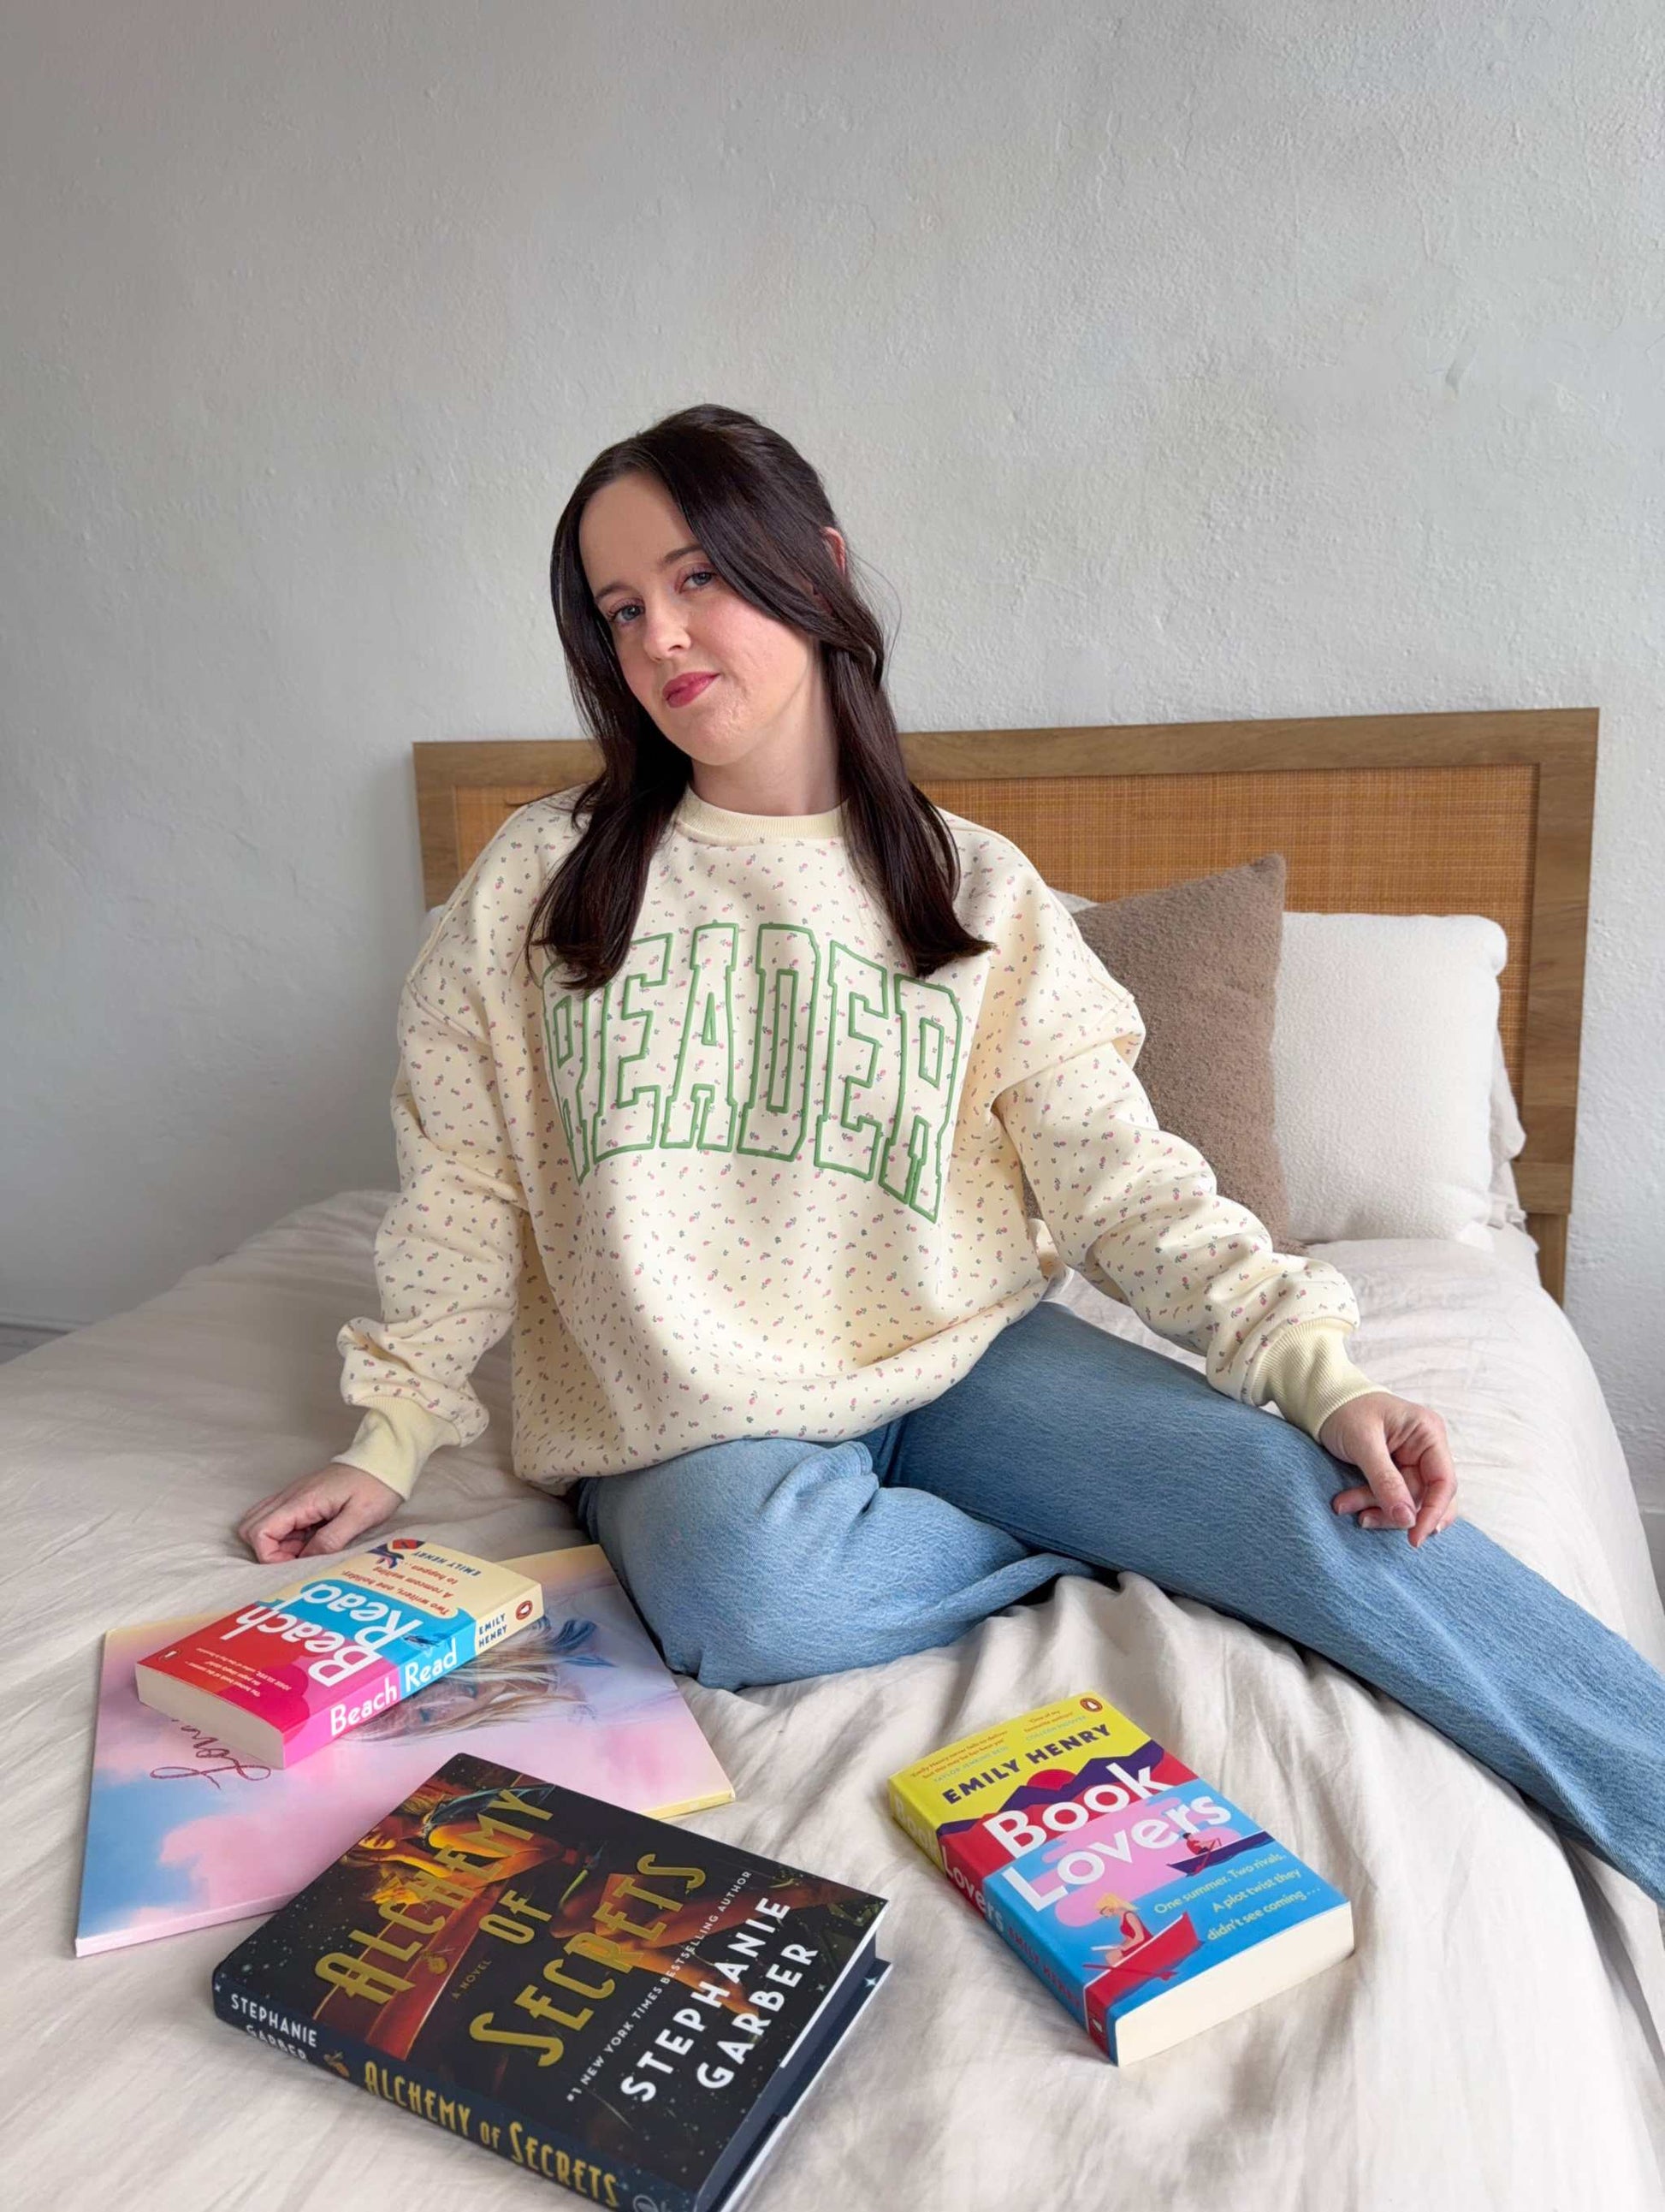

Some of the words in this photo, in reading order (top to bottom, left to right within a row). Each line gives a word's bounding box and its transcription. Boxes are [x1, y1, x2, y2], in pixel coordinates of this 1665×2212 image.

[542, 919, 963, 1224] READER
[376, 1582, 395, 1592] one
[412, 1551, 445, 1564] HENRY
[447, 1560, 481, 1576] EMILY
[220, 1606, 383, 1687] Beach
[271, 1583, 424, 1652] Read
[430, 1602, 450, 1616] Two
[478, 1613, 506, 1635] EMILY
[478, 1624, 507, 1648] HENRY
[330, 1676, 398, 1736] Beach
[404, 1637, 458, 1693] Read
[942, 1758, 1021, 1805] EMILY
[1025, 1723, 1111, 1764] HENRY
[982, 1762, 1176, 1859] Book
[942, 1845, 1004, 1932] Lovers
[1002, 1795, 1231, 1913] Lovers
[1154, 1897, 1182, 1913] One
[1182, 1877, 1230, 1902] summer.
[1228, 1865, 1254, 1878] Two
[1253, 1852, 1286, 1870] rivals.
[1212, 1901, 1224, 1913] A
[1224, 1889, 1248, 1910] plot
[1246, 1879, 1276, 1895] twist
[1274, 1868, 1301, 1886] they
[315, 1789, 554, 2004] ALCHEMY
[478, 1889, 552, 1944] OF
[1207, 1918, 1244, 1942] didn't
[1242, 1908, 1265, 1923] see
[452, 1990, 461, 2000] A
[460, 1959, 492, 1990] NOVEL
[470, 1853, 706, 2067] SECRETS
[580, 2055, 606, 2085] NEW
[603, 2021, 635, 2055] YORK
[632, 1986, 663, 2020] TIMES
[661, 1913, 719, 1985] BESTSELLING
[720, 1870, 752, 1913] AUTHOR
[231, 1993, 317, 2049] STEPHANIE
[620, 1897, 791, 2102] STEPHANIE
[696, 1943, 819, 2089] GARBER
[364, 2060, 471, 2137] ALCHEMY
[509, 2120, 619, 2209] SECRETS
